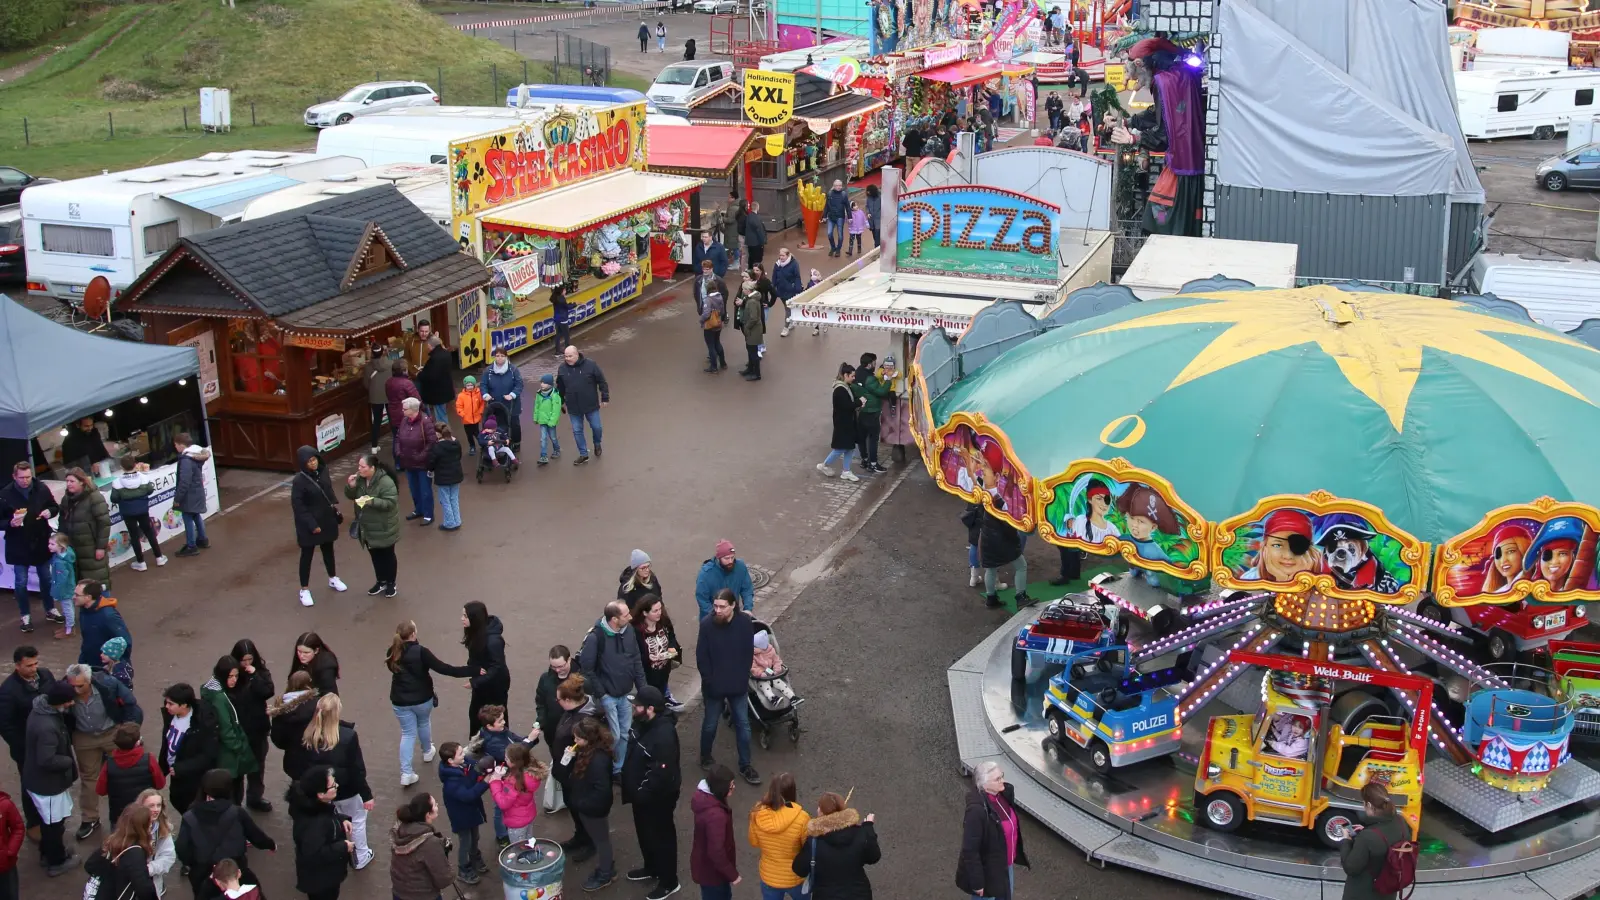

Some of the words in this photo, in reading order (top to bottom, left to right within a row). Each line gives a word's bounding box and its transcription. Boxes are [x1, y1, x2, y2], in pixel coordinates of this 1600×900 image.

[749, 85, 788, 105] XXL
[748, 106, 788, 125] Pommes
[460, 304, 481, 336] CARLO
[490, 324, 528, 357] DER
[532, 298, 597, 341] GRSSE
[599, 269, 641, 311] WURF
[801, 307, 828, 320] Cola
[837, 310, 871, 324] Fanta
[879, 313, 924, 327] Grappa
[320, 425, 341, 440] Langos
[1313, 665, 1339, 678] Weld
[1341, 669, 1375, 683] Built
[1131, 713, 1168, 734] POLIZEI
